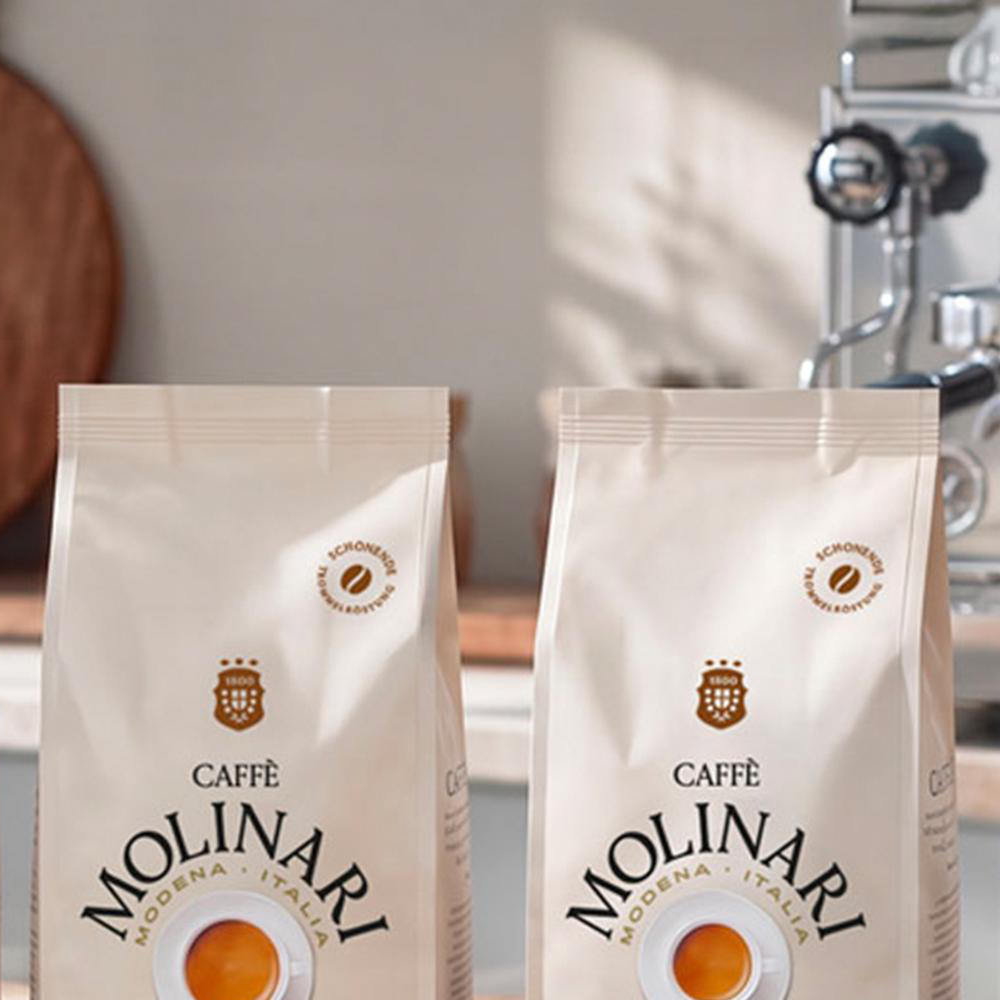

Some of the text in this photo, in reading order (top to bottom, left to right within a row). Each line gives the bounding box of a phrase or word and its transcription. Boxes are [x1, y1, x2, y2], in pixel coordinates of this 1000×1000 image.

[328, 540, 397, 576] SCHONENDE
[815, 542, 884, 575] SCHONENDE
[192, 758, 280, 788] CAFFÈ
[673, 757, 760, 788] CAFFÈ
[81, 801, 390, 944] MOLINARI
[565, 802, 866, 940] MOLINARI
[135, 863, 227, 947] MODENA
[261, 869, 329, 948] ITALIA
[620, 863, 809, 947] MODENA ITALIA
